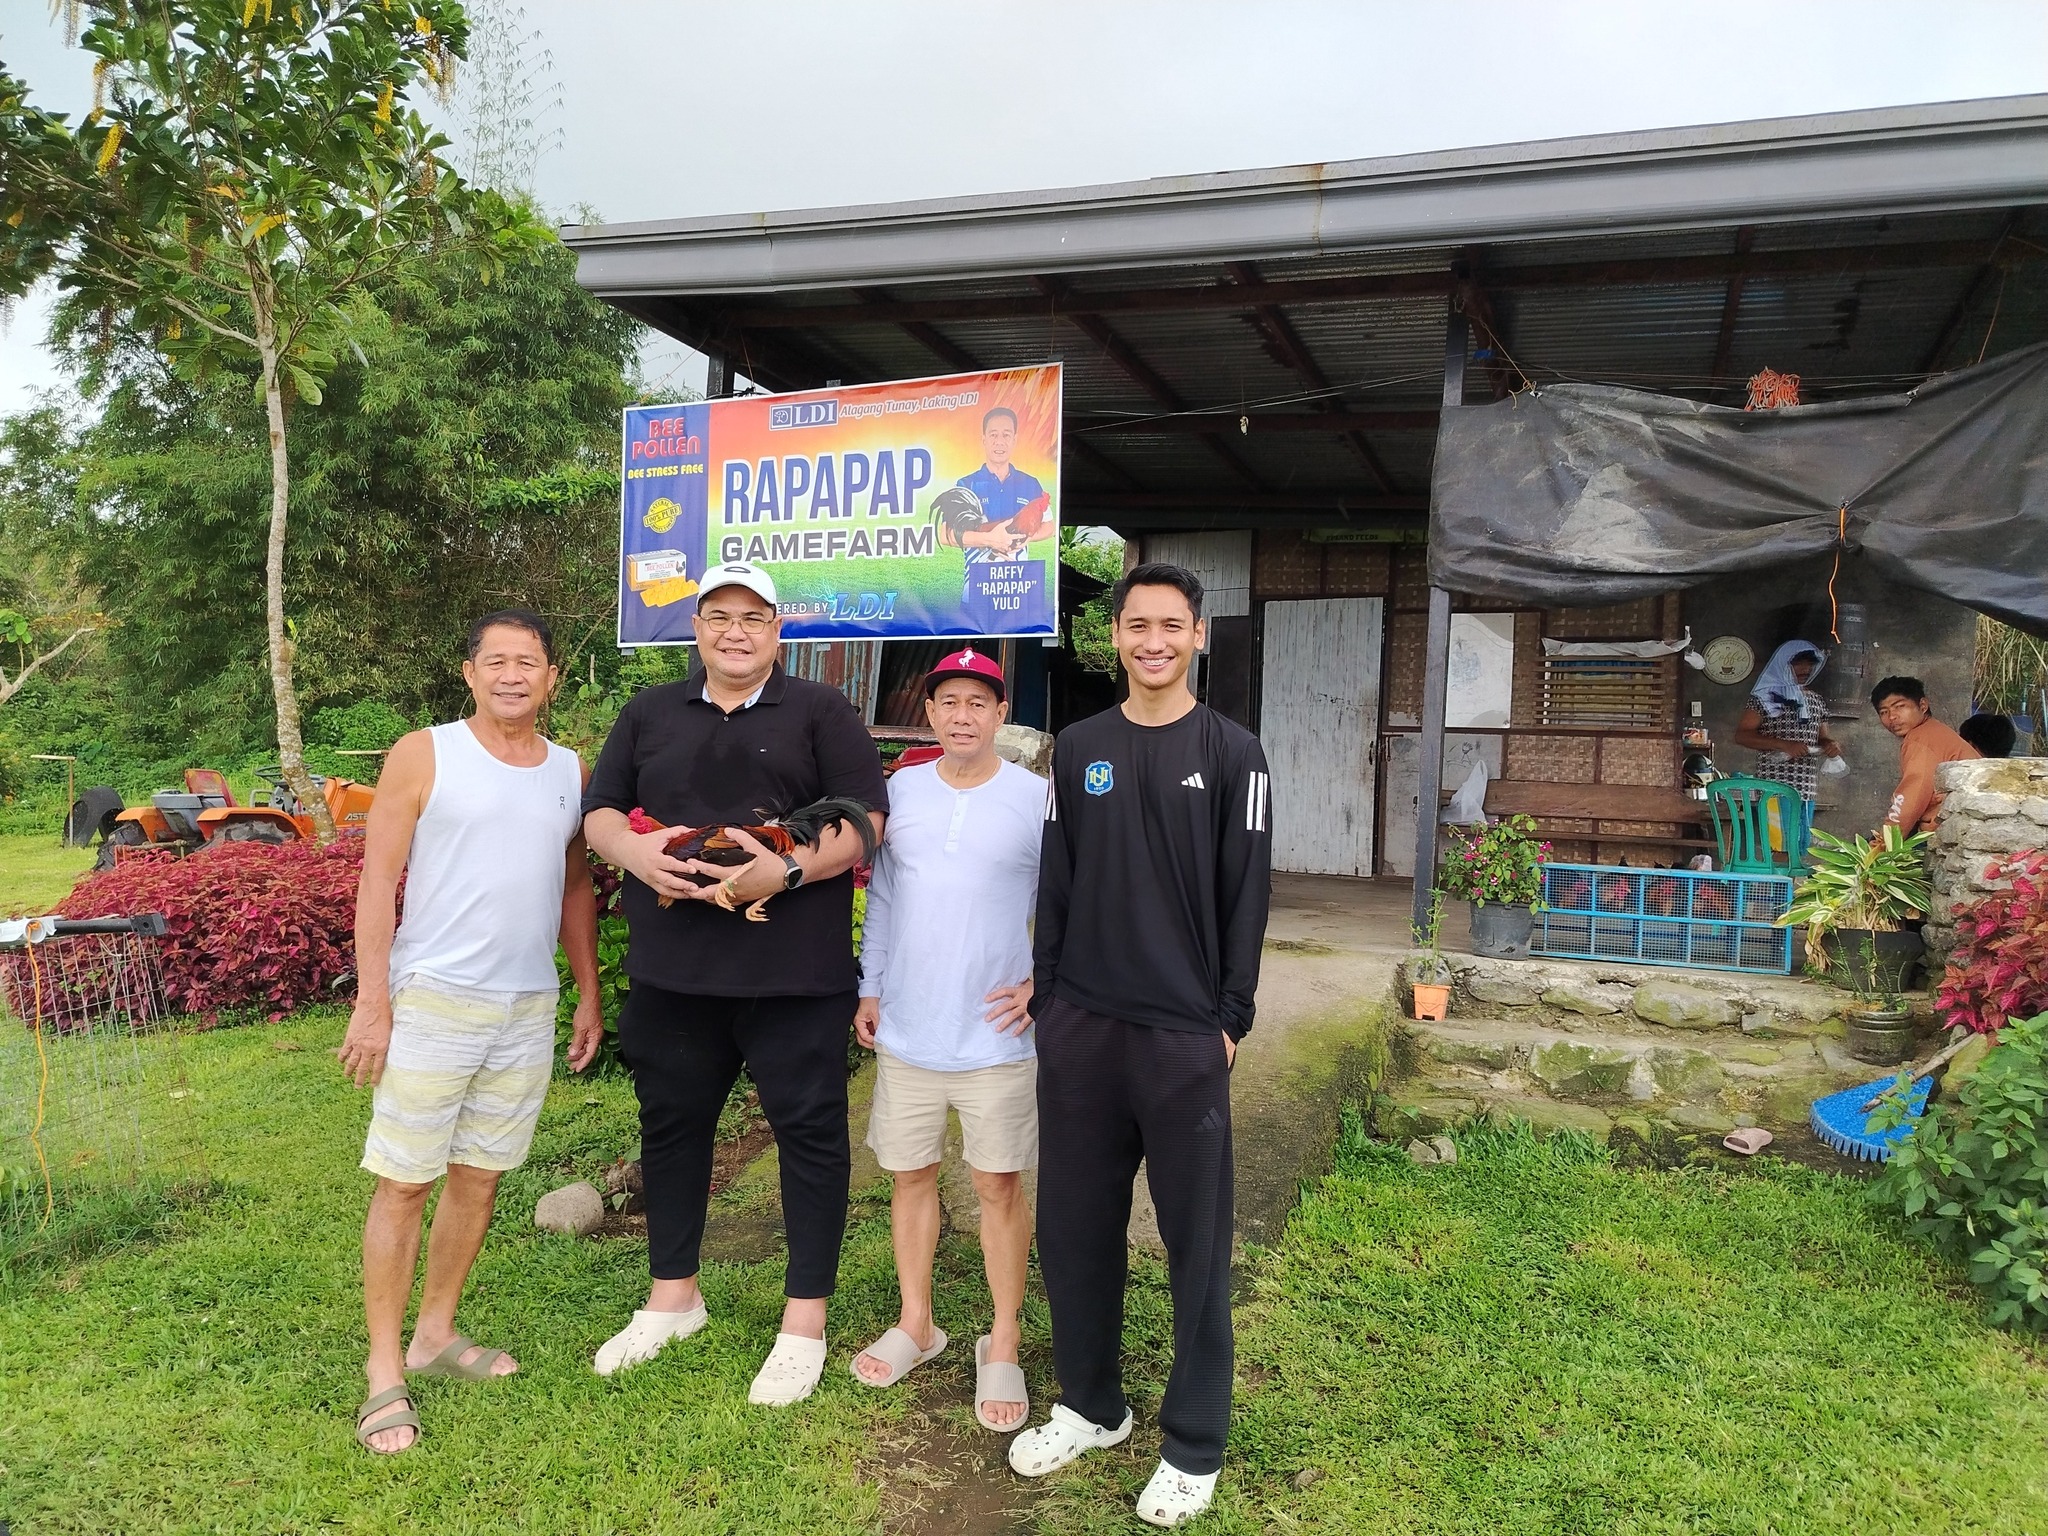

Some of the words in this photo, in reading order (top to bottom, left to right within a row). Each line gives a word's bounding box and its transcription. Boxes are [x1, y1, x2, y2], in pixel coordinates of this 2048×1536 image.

[793, 402, 836, 425] LDI
[840, 403, 883, 418] Alagang
[886, 400, 920, 413] Tunay,
[923, 394, 957, 409] Laking
[960, 392, 979, 405] LDI
[649, 417, 685, 438] BEE
[632, 436, 701, 460] POLLEN
[627, 468, 645, 480] BEE
[646, 465, 679, 478] STRESS
[681, 463, 704, 475] FREE
[724, 447, 932, 525] RAPAPAP
[721, 526, 934, 563] GAMEFARM
[990, 565, 1024, 579] RAFFY
[776, 602, 808, 614] ERED
[814, 601, 829, 613] BY
[829, 591, 899, 621] LDI
[992, 596, 1020, 611] YULO
